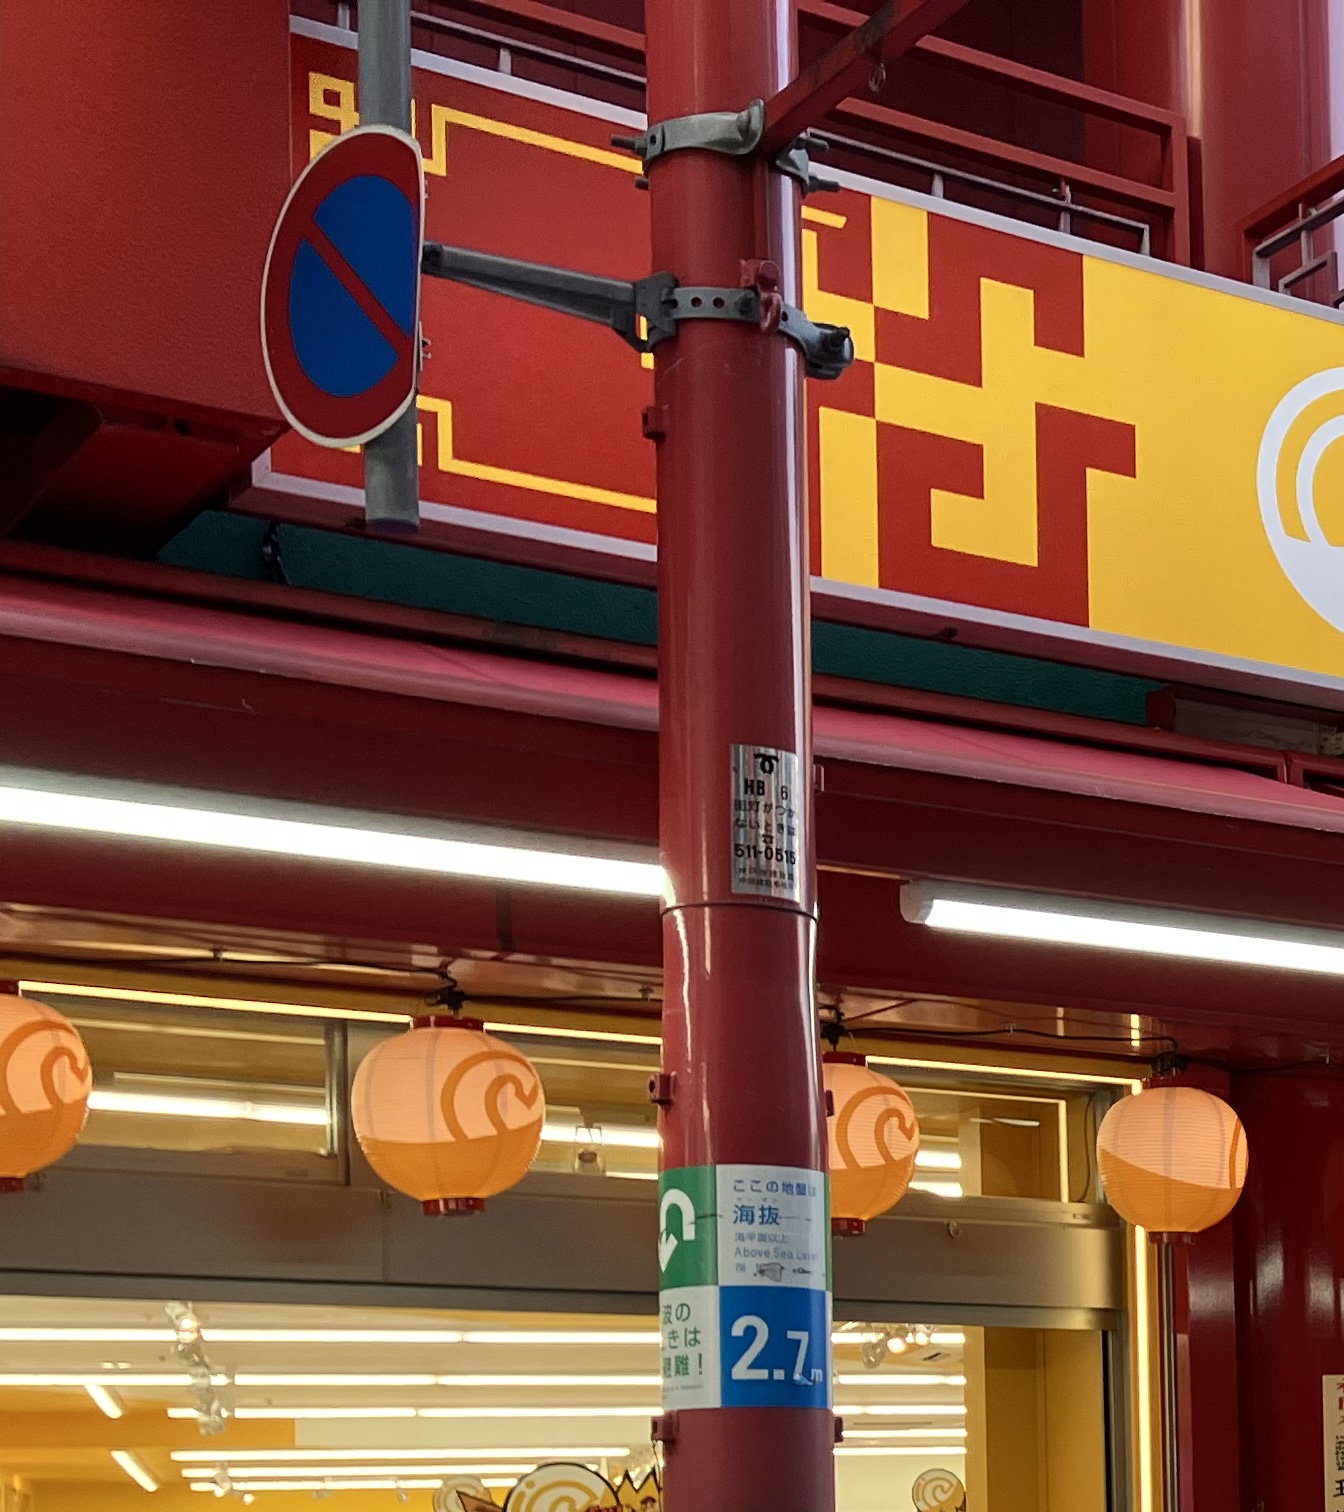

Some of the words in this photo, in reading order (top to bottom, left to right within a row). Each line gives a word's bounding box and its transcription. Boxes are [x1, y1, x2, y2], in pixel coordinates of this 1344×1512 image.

[743, 777, 766, 797] HB
[780, 785, 789, 801] 6
[734, 843, 796, 866] 511-0515
[733, 1179, 817, 1197] ここの地盤は
[732, 1204, 781, 1226] 海抜
[734, 1246, 771, 1259] Above
[773, 1247, 795, 1261] Sea
